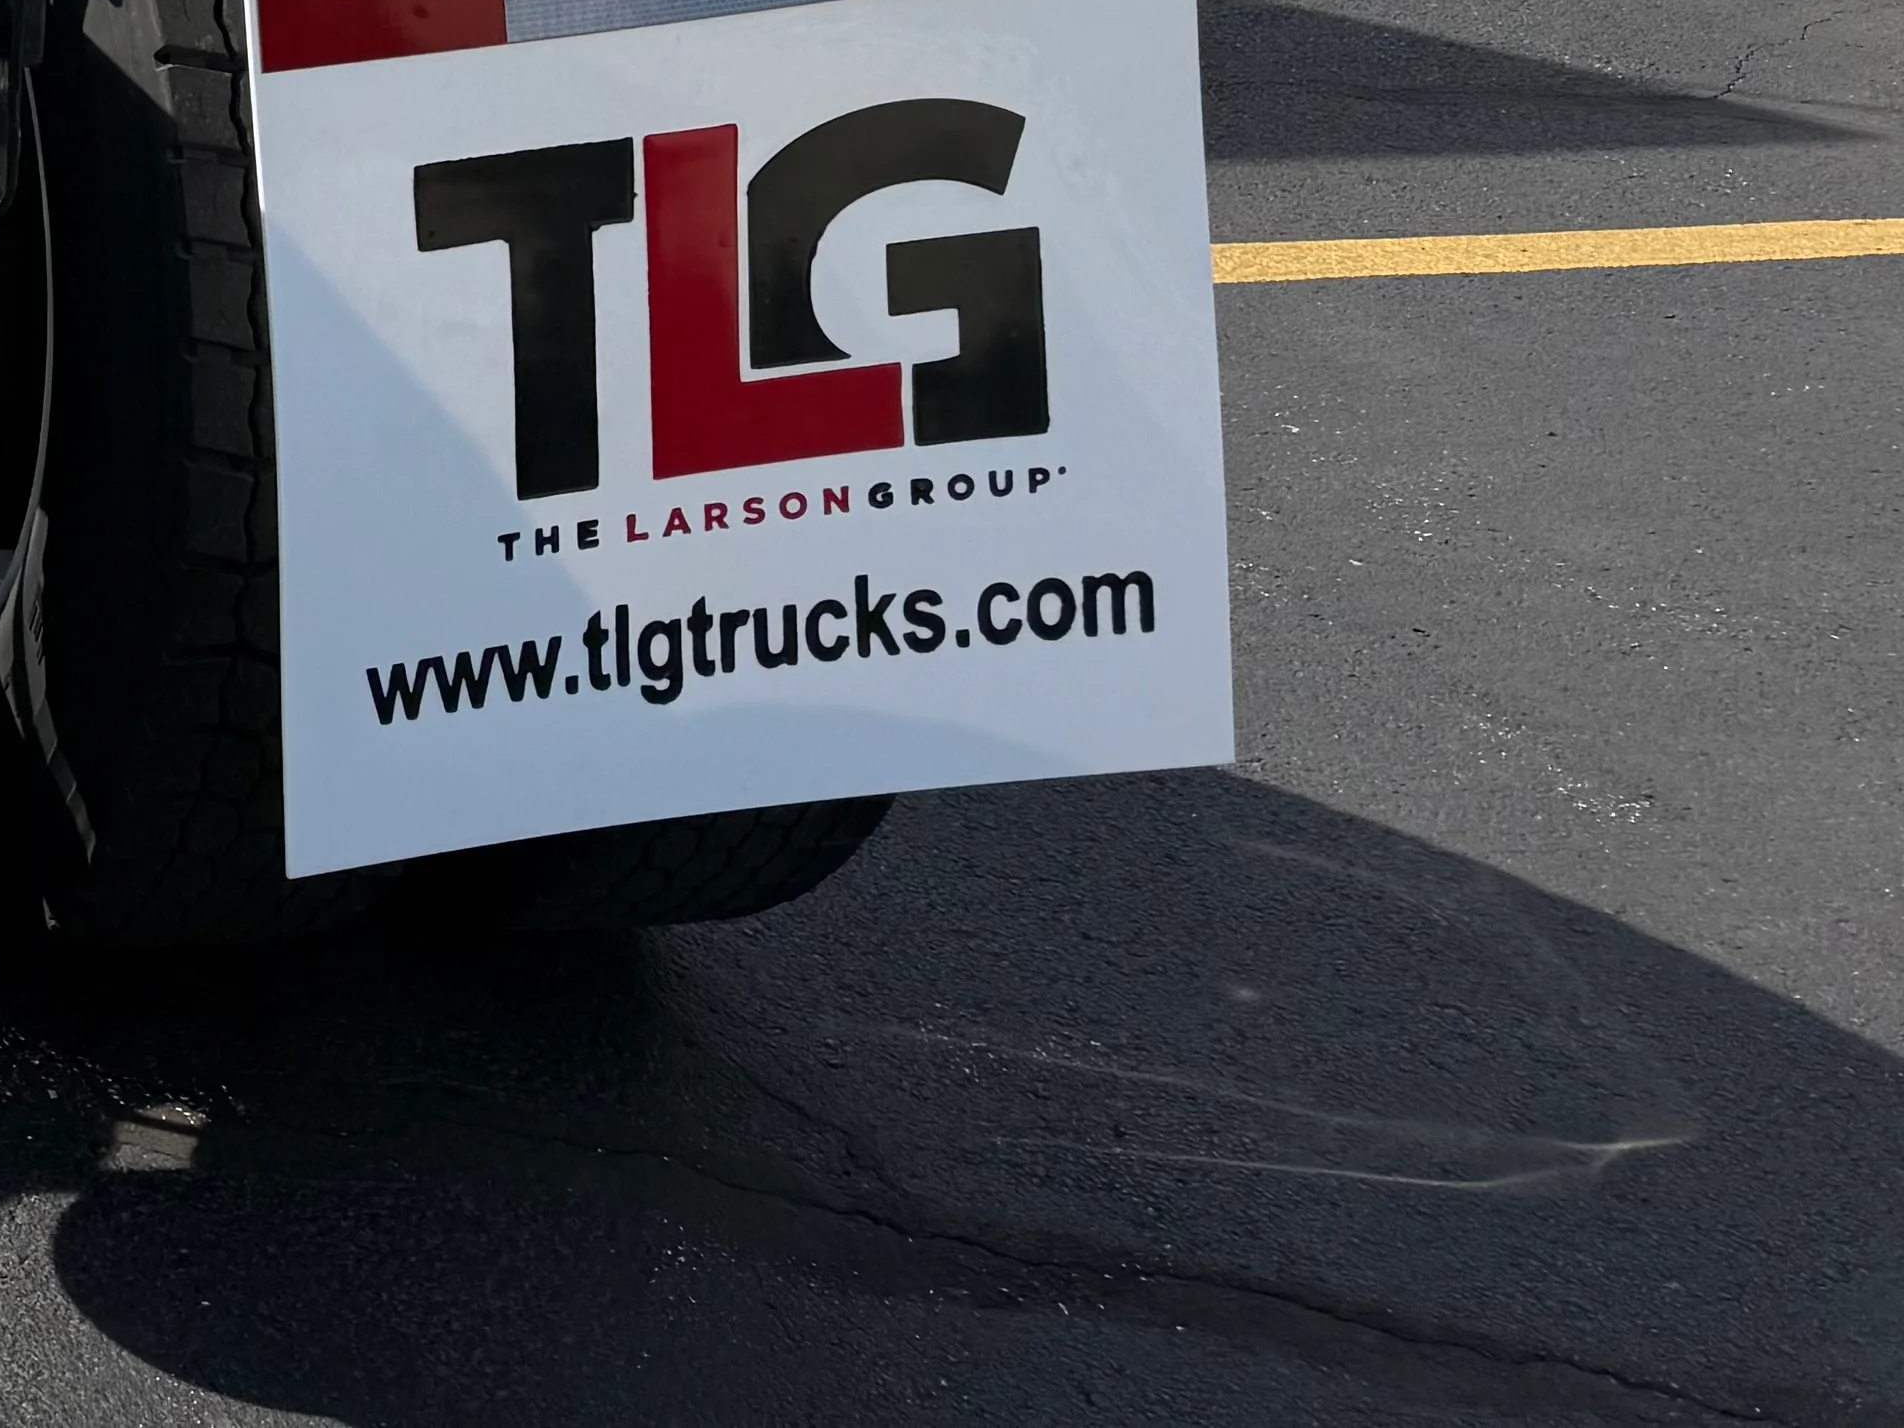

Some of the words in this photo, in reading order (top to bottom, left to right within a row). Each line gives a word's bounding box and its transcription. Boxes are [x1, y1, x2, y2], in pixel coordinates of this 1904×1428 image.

[413, 97, 1050, 502] TLG
[497, 518, 601, 562] THE
[624, 485, 851, 543] LARSON
[866, 466, 1052, 511] GROUP
[366, 568, 1155, 725] www.tlgtrucks.com
